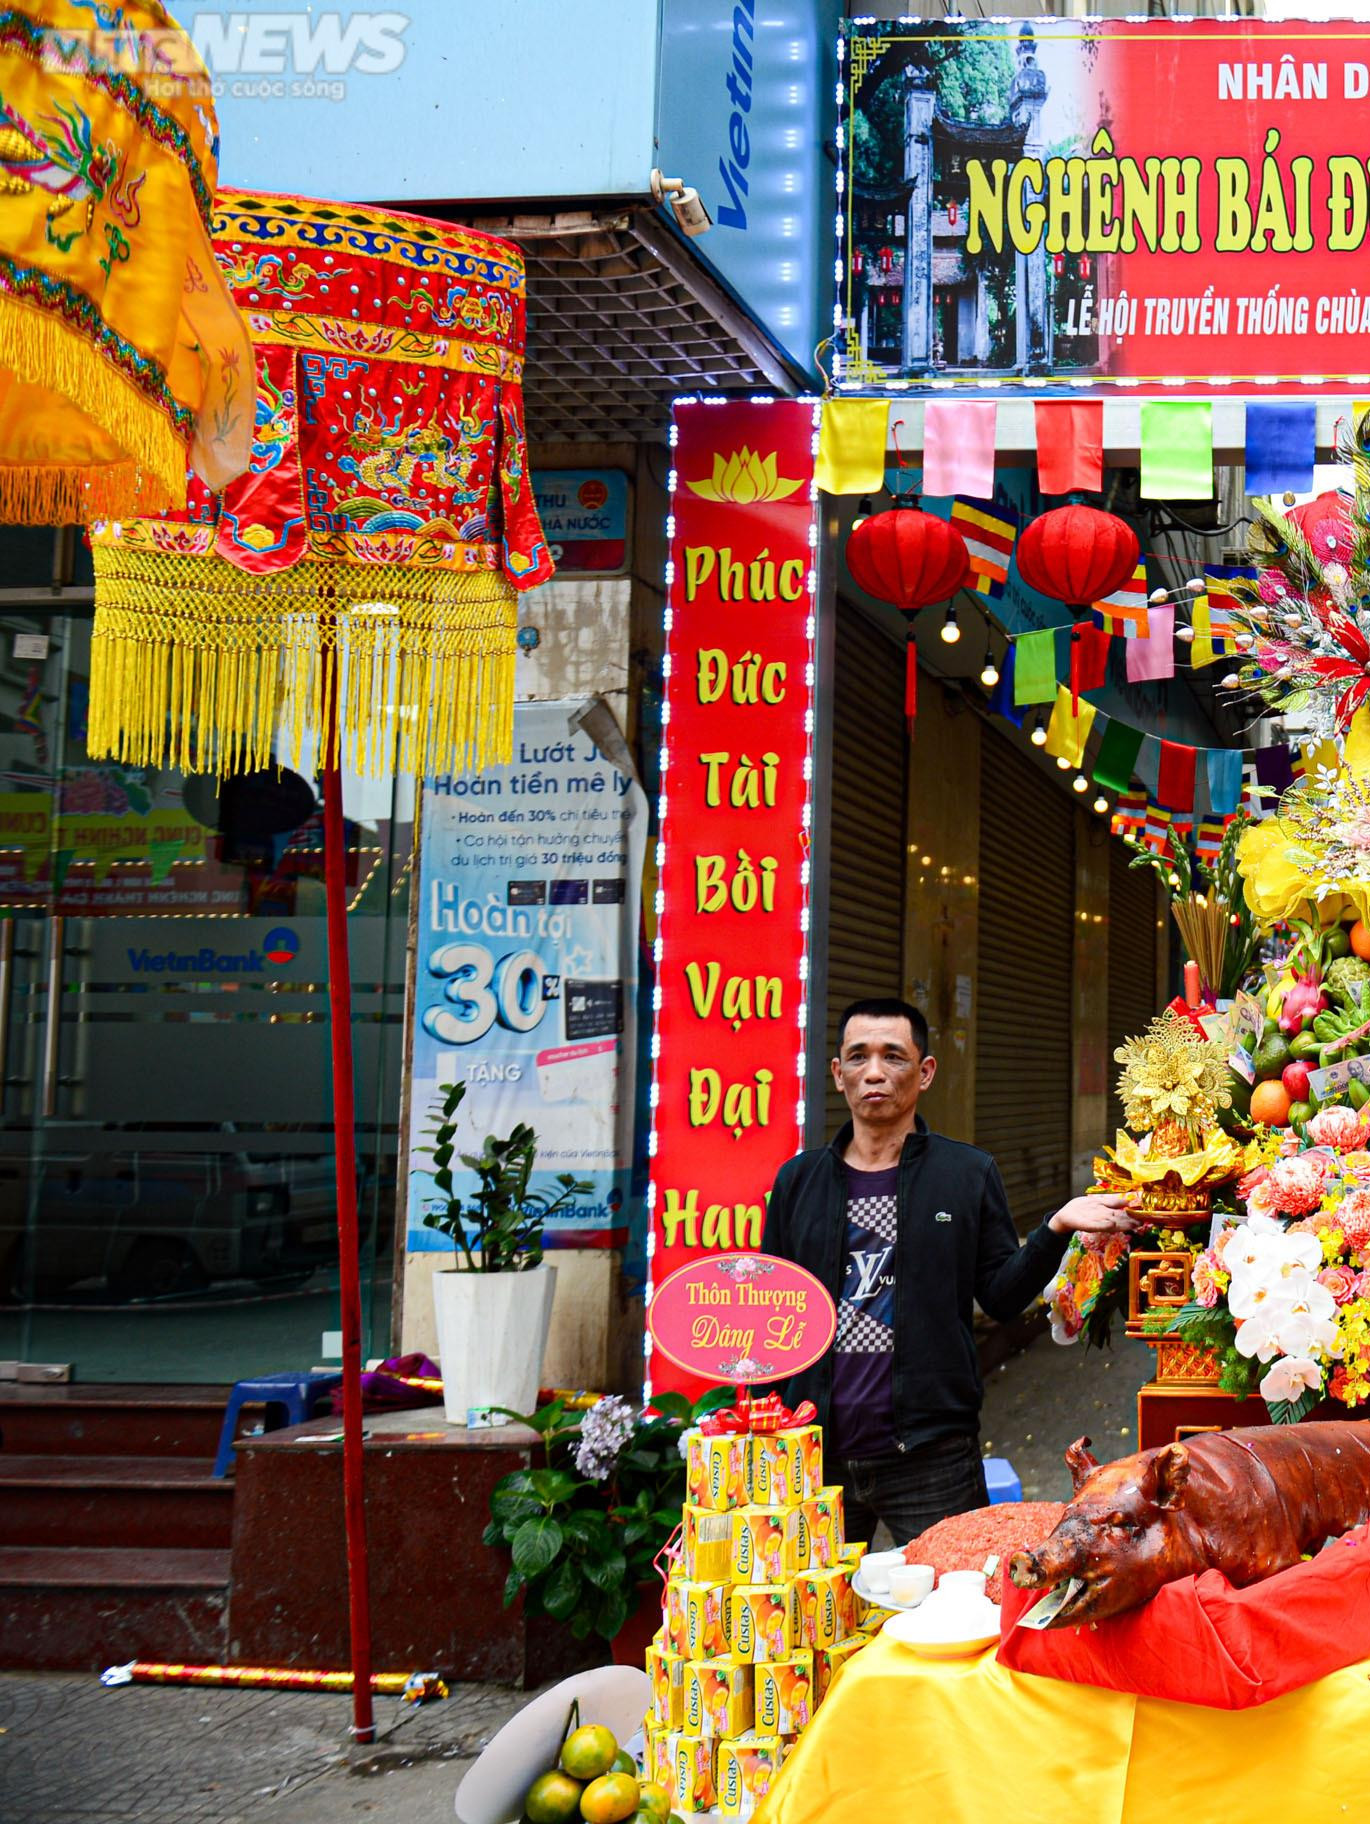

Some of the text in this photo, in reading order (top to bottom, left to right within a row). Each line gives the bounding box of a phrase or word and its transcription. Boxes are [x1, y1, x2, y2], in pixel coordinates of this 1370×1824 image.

[1217, 54, 1328, 100] NHÂN
[717, 0, 755, 230] Vietin
[965, 126, 1201, 254] NGHÊNH
[1215, 128, 1314, 253] BÁI
[1067, 285, 1093, 335] LỄ
[1099, 290, 1135, 345] HỘI
[1144, 284, 1230, 335] TRUYỀN
[1237, 283, 1309, 335] THỐNG
[543, 515, 562, 530] HÀ
[520, 742, 575, 763] Lướt
[434, 773, 501, 795] Hoàn
[567, 772, 605, 792] mê
[613, 770, 632, 796] ly
[459, 809, 493, 823] Hoàn
[498, 807, 524, 822] đến
[528, 808, 556, 822] 30%
[541, 853, 558, 865] 30
[562, 851, 593, 867] triệu
[431, 879, 530, 938] Hoàn
[663, 546, 804, 1249] Phúc Đức Tài Bồi Vạn Đại Han
[128, 949, 265, 973] VietinBank
[686, 1281, 807, 1312] Thôn Thượng
[691, 1314, 807, 1360] Dâng Lễ
[793, 1447, 802, 1495] Custas
[737, 1525, 749, 1575] Custas
[737, 1604, 750, 1655] Custas
[823, 1590, 834, 1638] Custas
[687, 1678, 699, 1728] Custas
[761, 1677, 775, 1728] Custas
[724, 1758, 738, 1808] Custas
